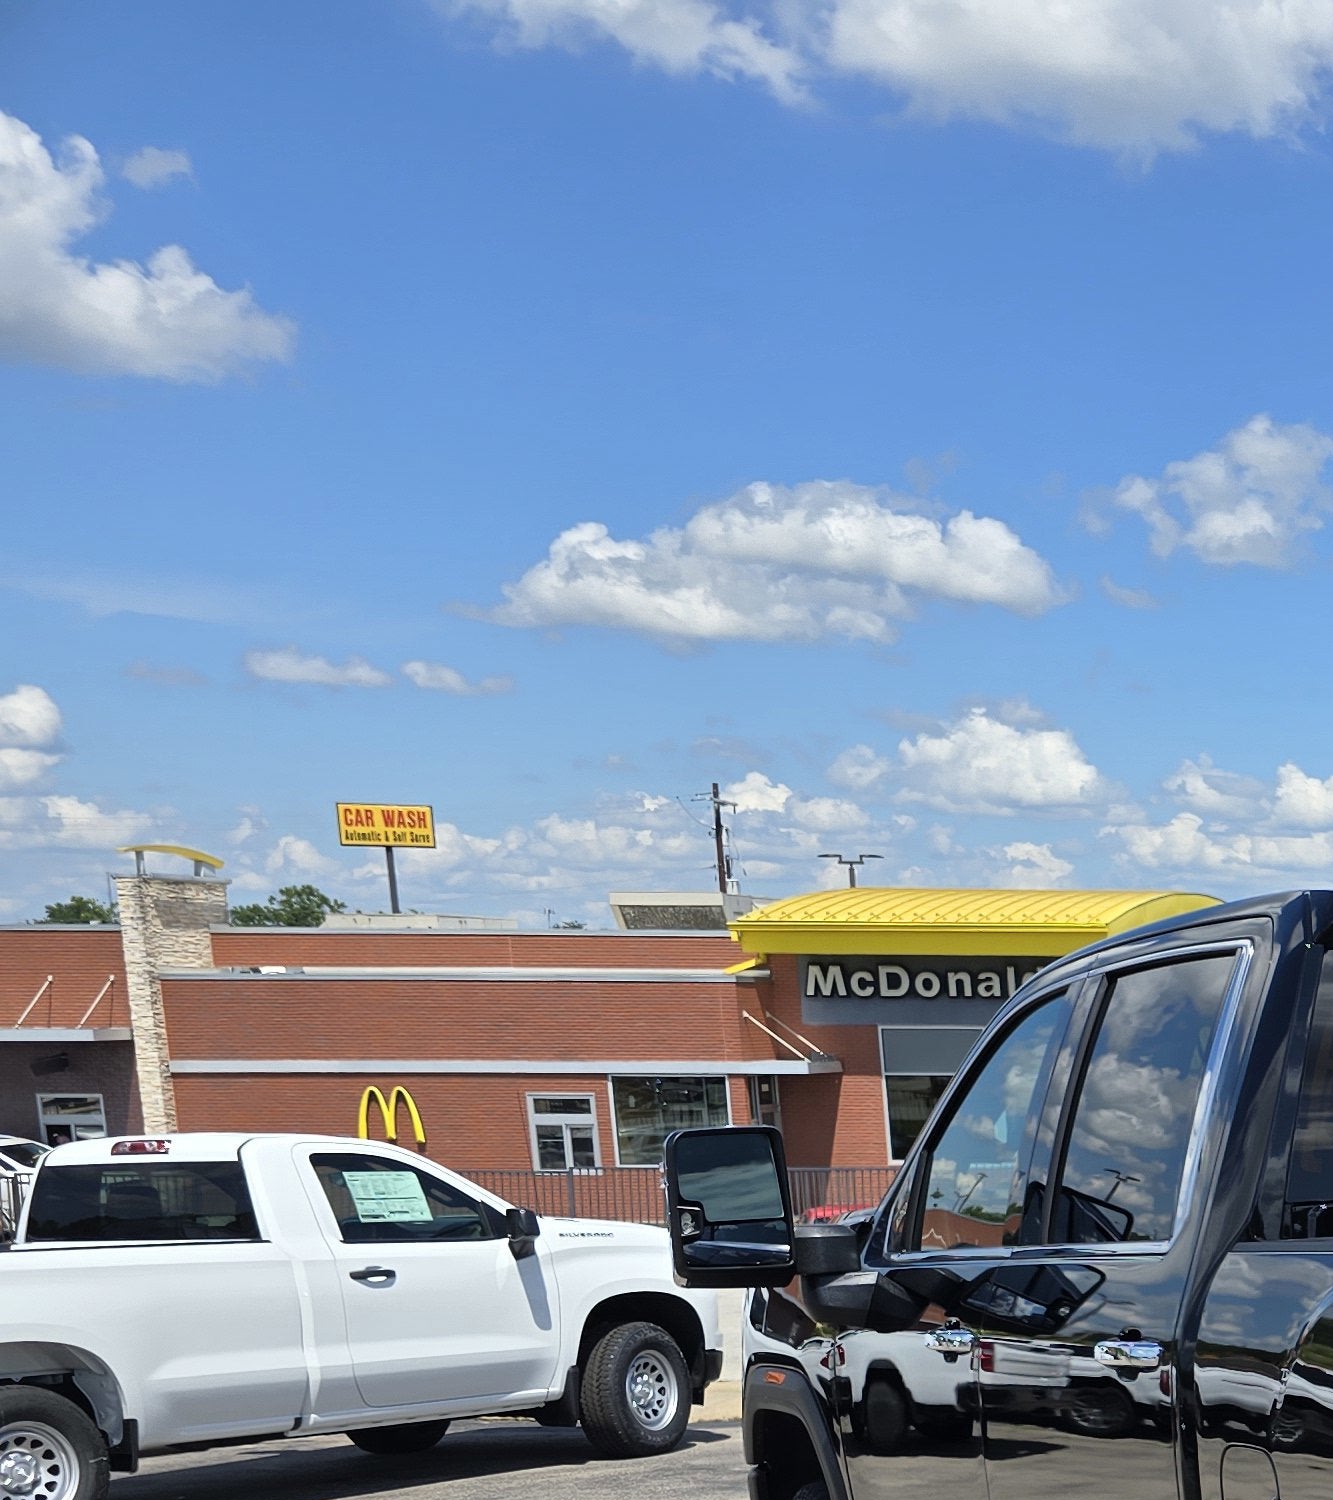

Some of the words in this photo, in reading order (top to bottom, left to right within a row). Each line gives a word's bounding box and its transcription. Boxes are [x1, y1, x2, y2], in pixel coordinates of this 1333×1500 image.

[344, 808, 375, 827] CAR
[381, 809, 428, 828] WASH
[345, 830, 381, 842] Automatic
